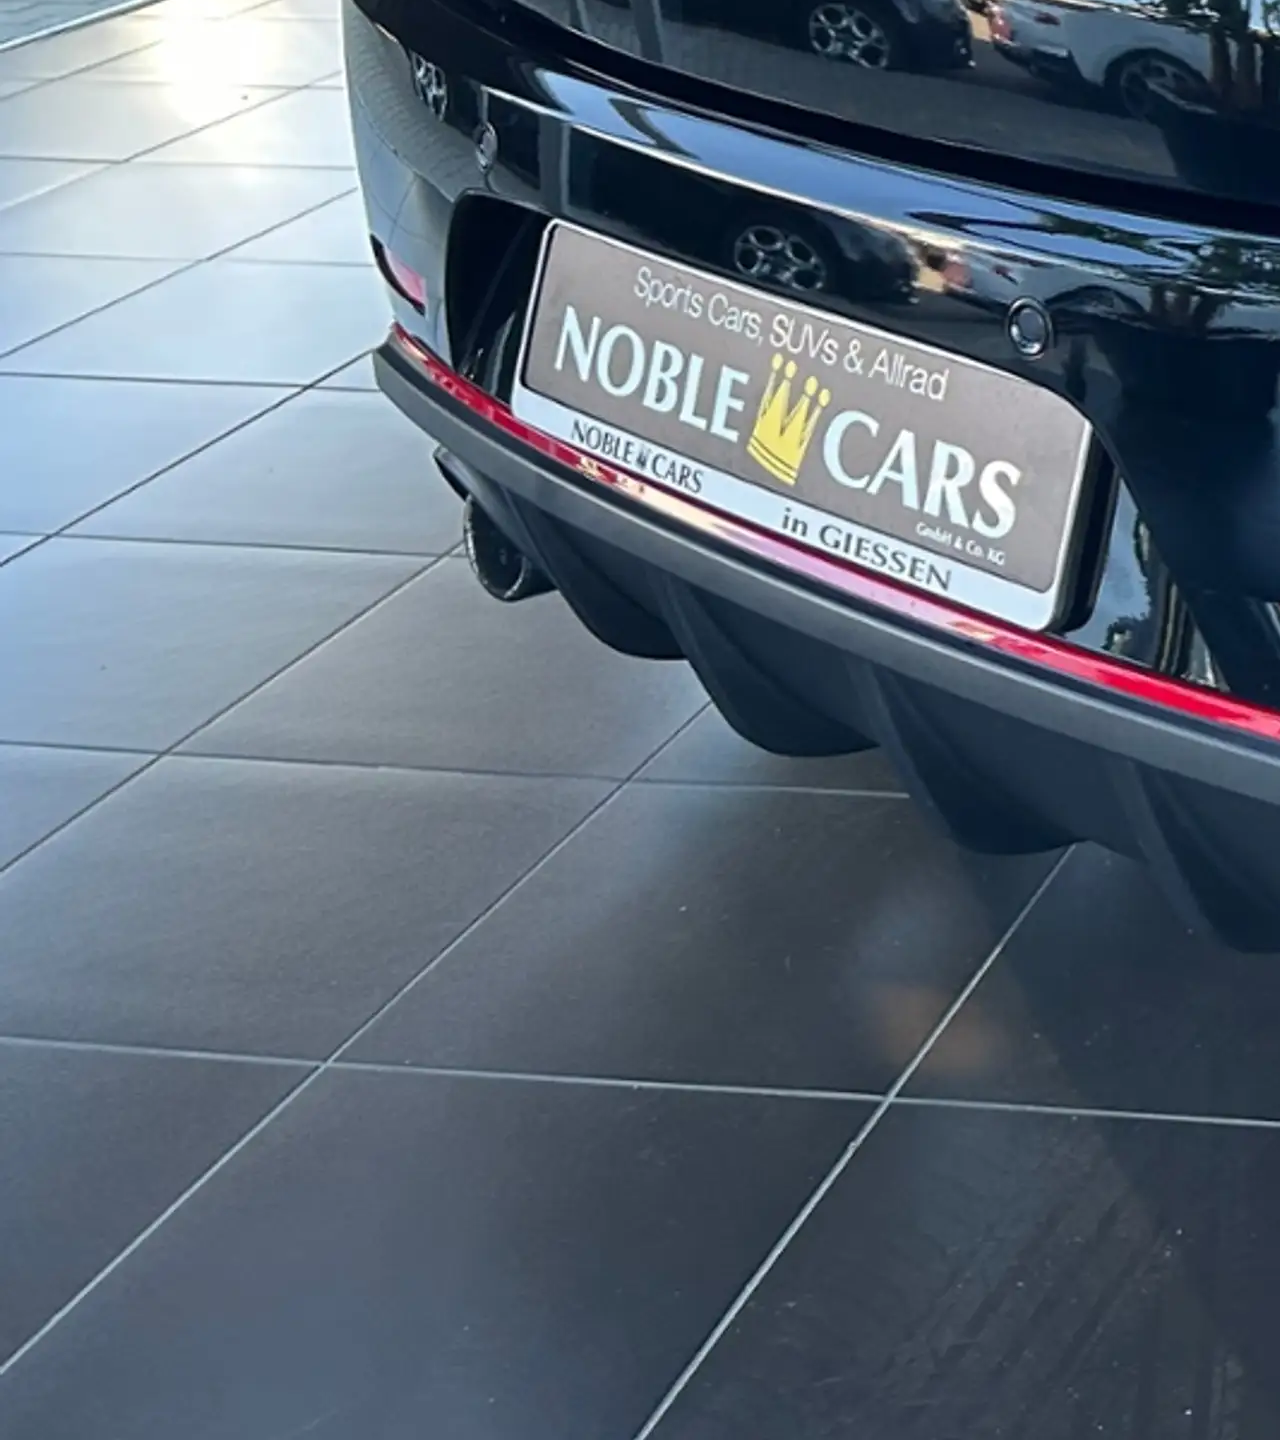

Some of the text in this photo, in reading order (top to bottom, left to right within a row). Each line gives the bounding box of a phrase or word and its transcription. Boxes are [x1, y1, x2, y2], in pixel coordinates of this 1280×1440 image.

[633, 266, 950, 402] Sports Cars, SUVs & Allrad
[554, 304, 1021, 539] NOBLE CARS
[571, 420, 704, 493] NOBLE CARS
[781, 506, 952, 592] in GIESSEN
[915, 521, 953, 546] GmbH
[954, 535, 964, 550] &
[987, 547, 1005, 565] KG
